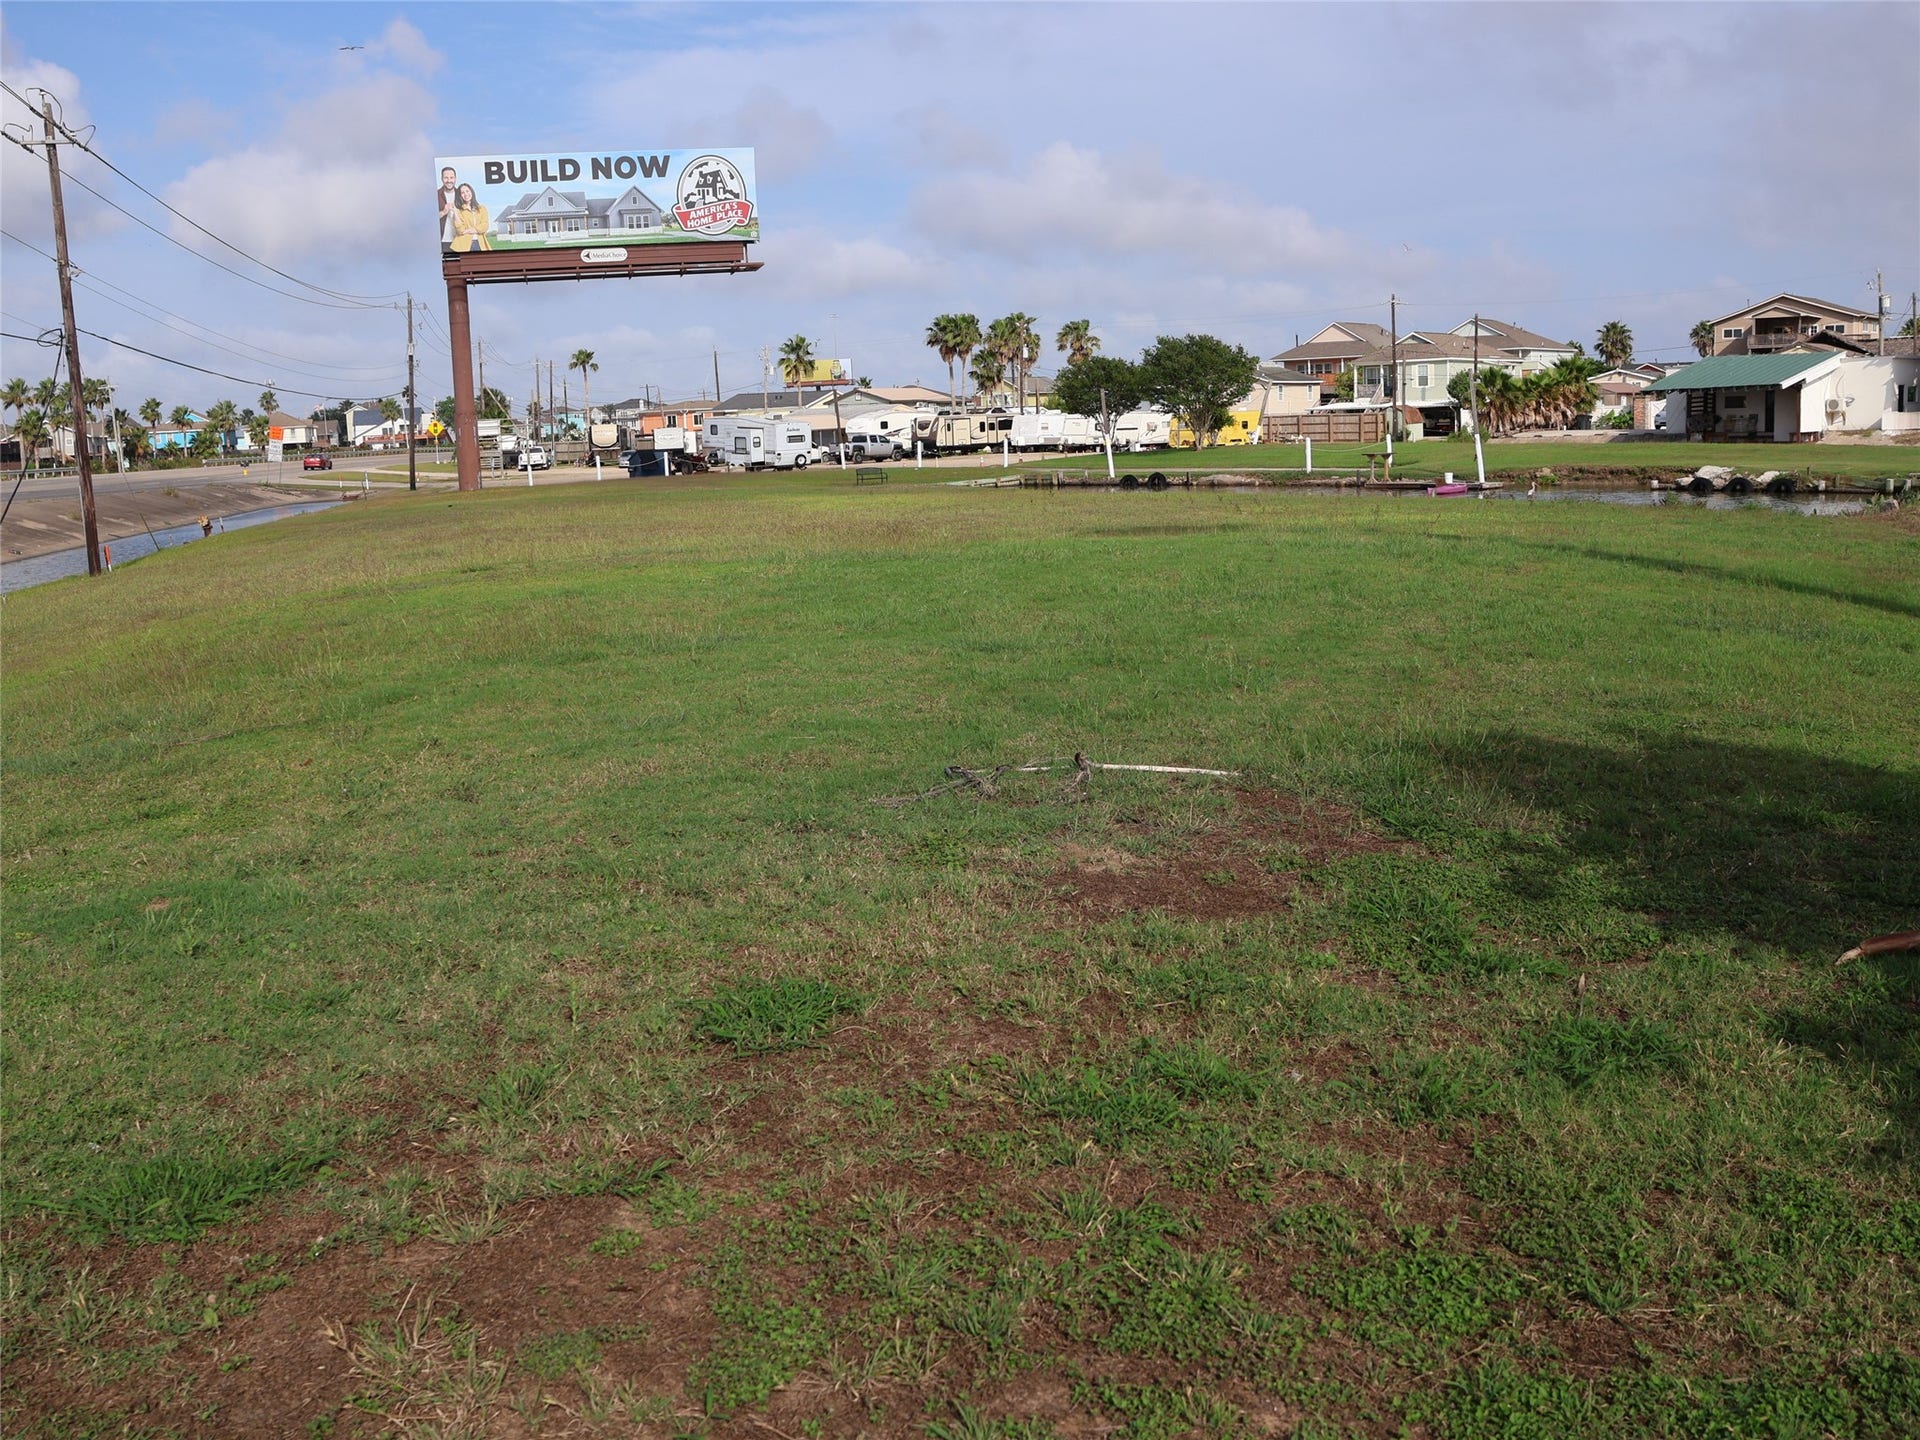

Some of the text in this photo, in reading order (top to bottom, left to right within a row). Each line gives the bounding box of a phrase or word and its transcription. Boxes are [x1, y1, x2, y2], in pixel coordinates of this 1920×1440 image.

[484, 155, 671, 185] BUILD NOW
[686, 209, 743, 228] HOME PLACE
[689, 202, 738, 220] AMERICA'S
